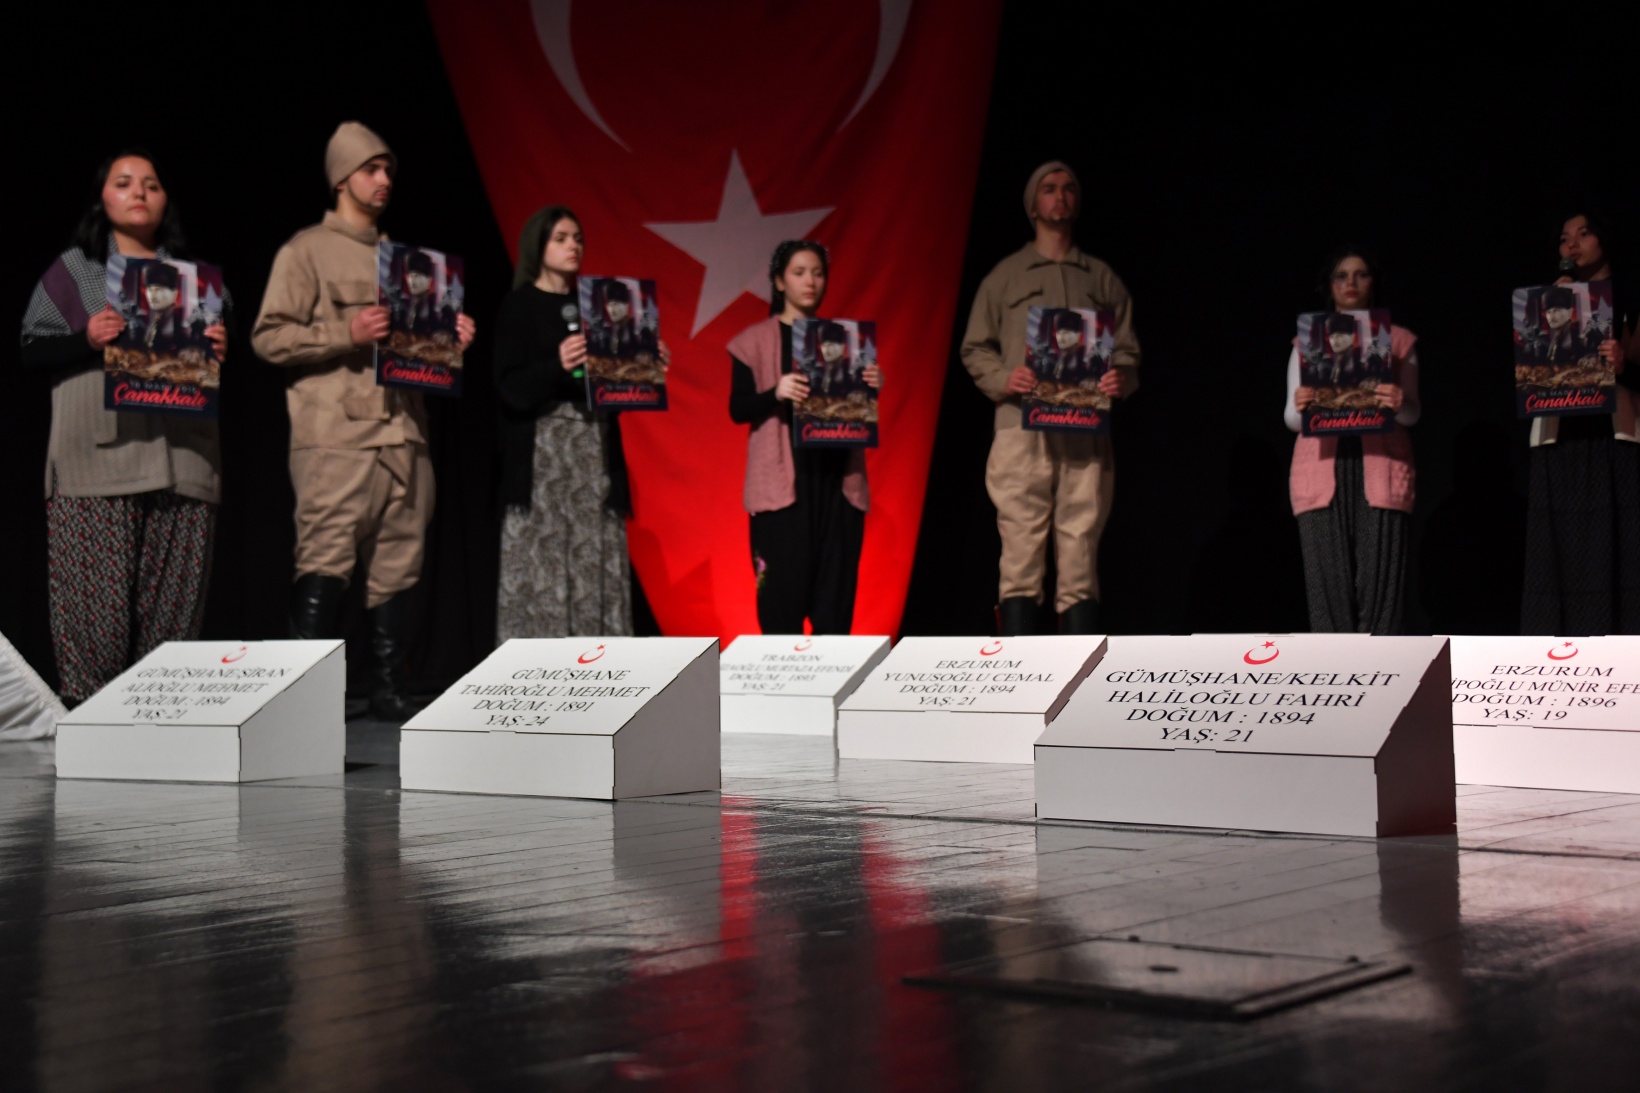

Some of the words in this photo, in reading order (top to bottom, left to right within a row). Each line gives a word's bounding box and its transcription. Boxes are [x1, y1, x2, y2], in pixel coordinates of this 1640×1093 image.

[935, 660, 1023, 669] ERZURUM
[1490, 665, 1615, 677] ERZURUM
[512, 667, 631, 682] GÜMÜŞHANE
[883, 671, 990, 682] YUNUSOĞLU
[991, 673, 1055, 682] CEMAL
[1105, 669, 1400, 687] GÜMÜŞHANE/KELKİT
[198, 683, 269, 693] MEHMET
[459, 683, 563, 697] TAHİROĞLU
[561, 686, 650, 698] MEHMET
[899, 683, 967, 693] DOĞUM
[979, 685, 1017, 694] 1894
[1528, 679, 1600, 693] MÜNİR
[194, 696, 231, 706] 1894
[472, 698, 545, 711] DOĞUM
[554, 701, 595, 712] 1891
[918, 696, 954, 707] YAŞ:
[957, 697, 977, 706] 21
[1105, 690, 1269, 706] HALİLOĞLU
[1274, 691, 1367, 707] FAHRİ
[1452, 692, 1547, 706] DOĞUM
[1566, 696, 1618, 708] 1896
[167, 709, 188, 719] 21
[1125, 706, 1237, 723] DOĞUM
[1255, 711, 1317, 725] 1894
[1483, 708, 1534, 721] YAŞ:
[1542, 710, 1568, 721] 19
[486, 715, 525, 727] YAŞ:
[524, 716, 551, 727] 24
[1160, 727, 1218, 744] YAŞ:
[1223, 730, 1254, 743] 21
